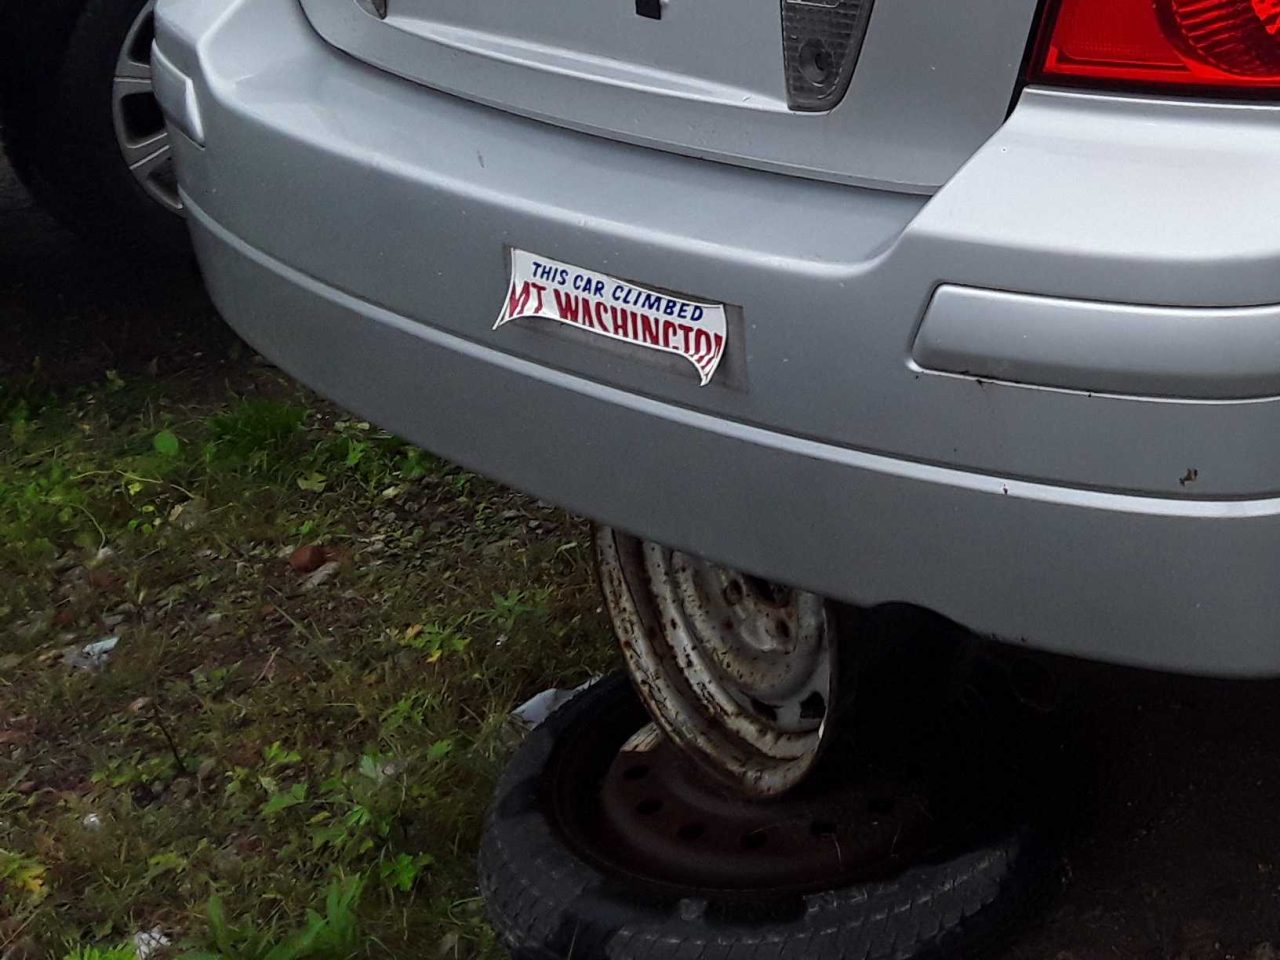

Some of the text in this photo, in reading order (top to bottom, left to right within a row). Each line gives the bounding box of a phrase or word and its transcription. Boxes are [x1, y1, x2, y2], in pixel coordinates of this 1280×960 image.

[531, 261, 704, 322] THIS CAR CLIMBED
